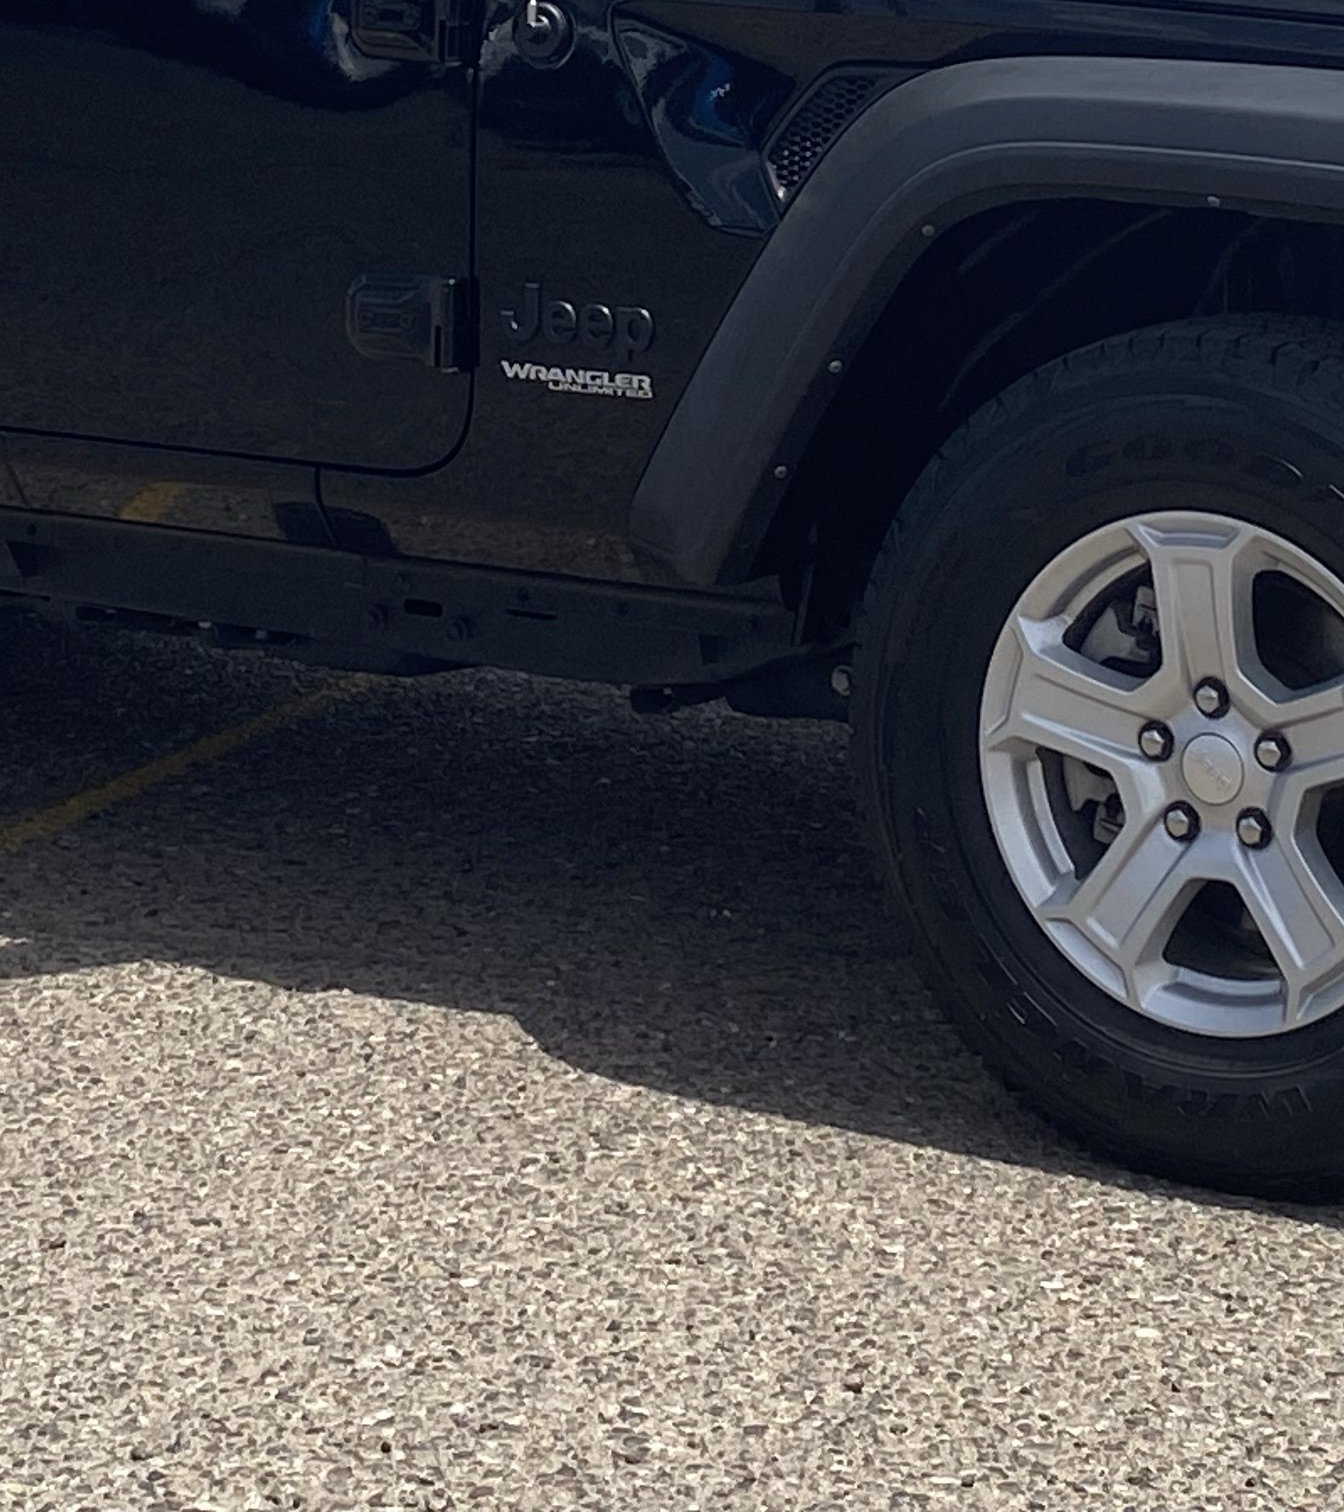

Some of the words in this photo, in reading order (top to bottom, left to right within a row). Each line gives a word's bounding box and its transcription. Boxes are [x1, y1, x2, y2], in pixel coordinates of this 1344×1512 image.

[500, 282, 654, 363] Jeep
[500, 360, 652, 390] WRANGLER
[547, 381, 654, 399] UNLIMITED
